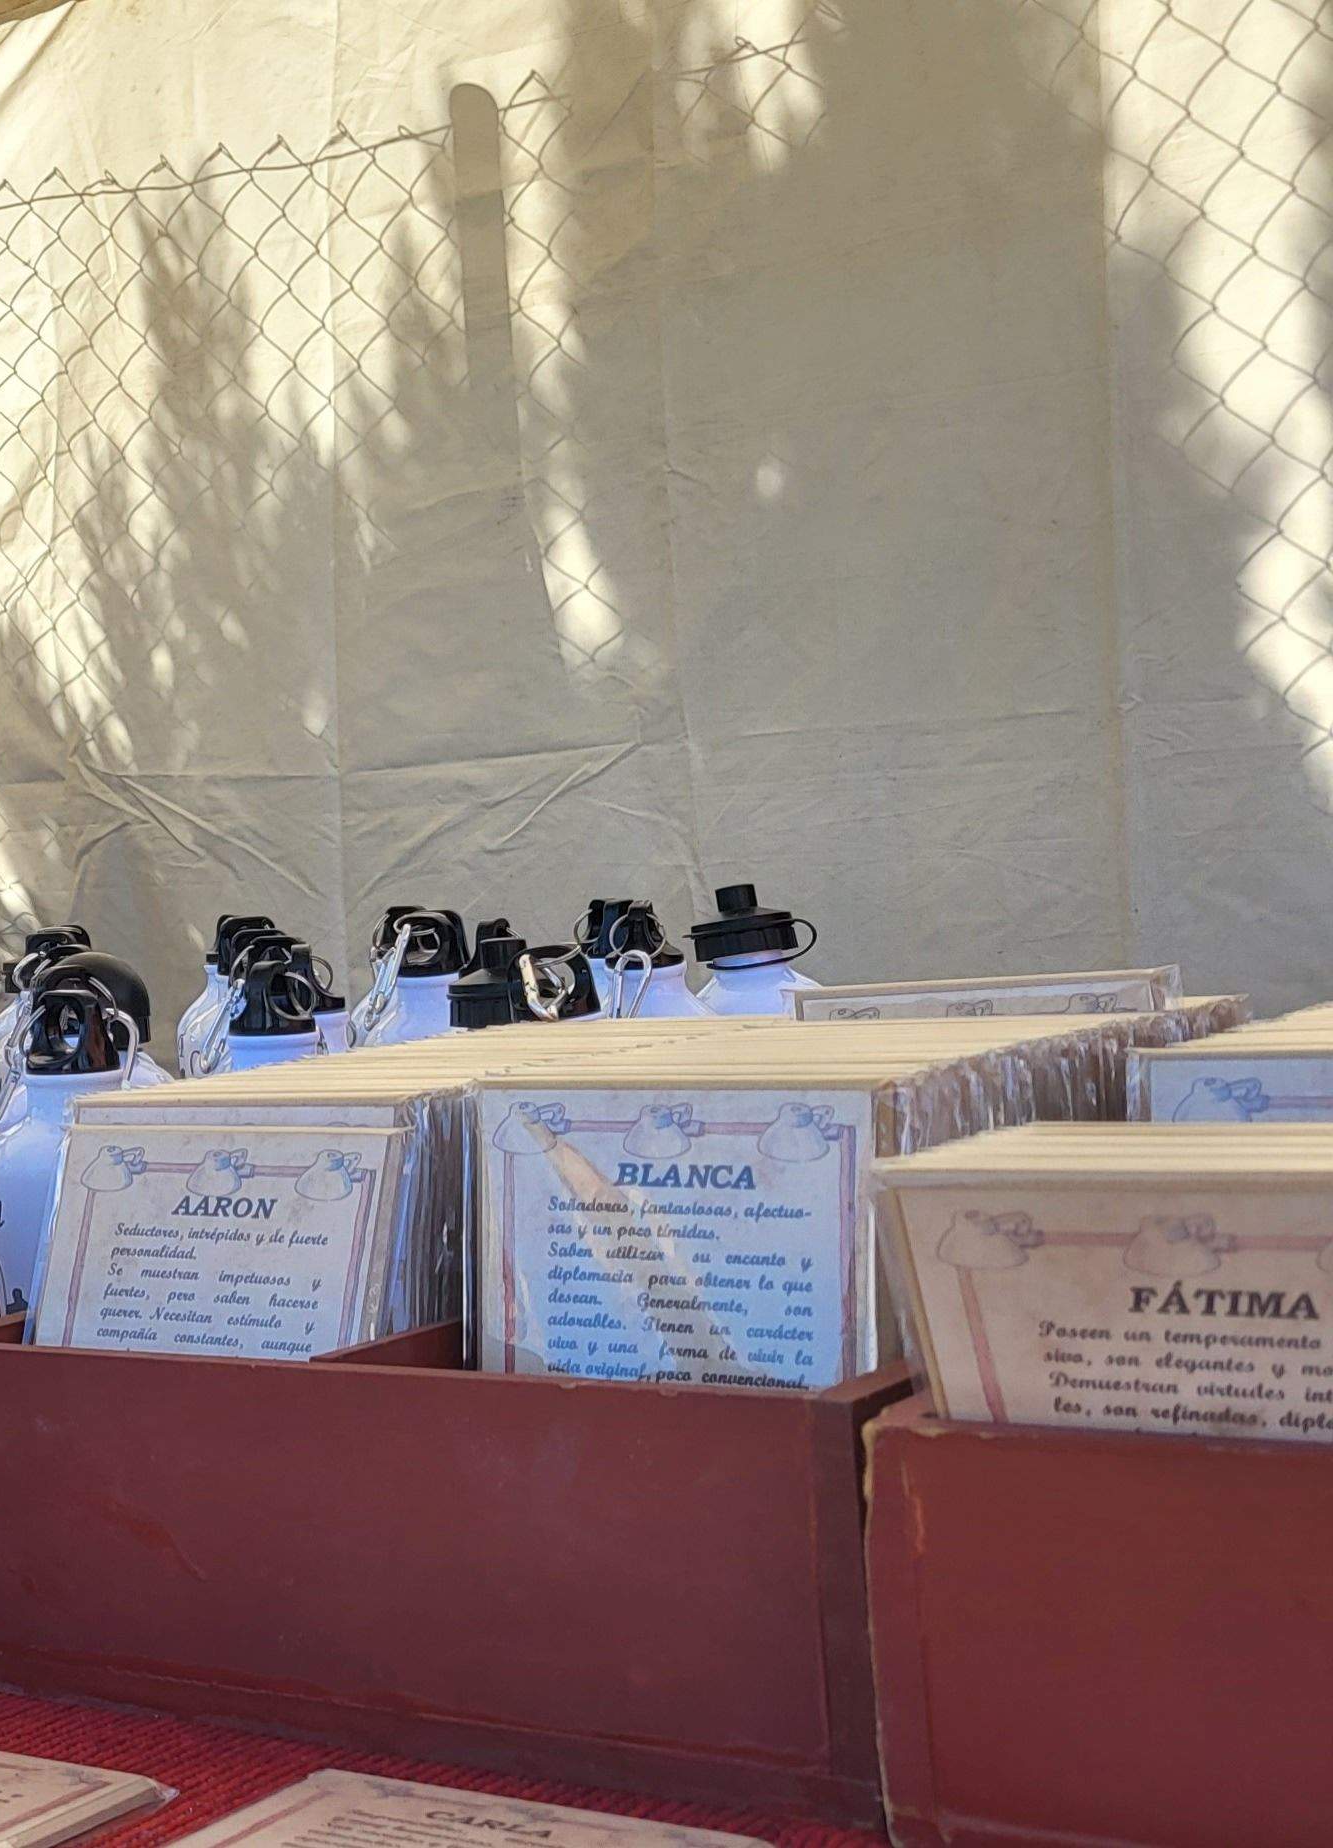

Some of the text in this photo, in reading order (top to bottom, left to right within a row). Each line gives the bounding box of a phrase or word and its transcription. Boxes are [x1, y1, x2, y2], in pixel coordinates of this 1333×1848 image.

[613, 1162, 756, 1190] BLANCA
[171, 1195, 278, 1219] AARON
[744, 1202, 812, 1222] afectuo-
[115, 1222, 329, 1248] Seductores, intrépidos y de fuerte
[547, 1222, 720, 1241] sas y un poco tímidas.
[111, 1245, 197, 1260] personalidad.
[547, 1241, 813, 1273] Saben utilizar su encanto y
[107, 1262, 322, 1292] Se muestran impetuosos y
[547, 1265, 813, 1296] diplomacia para obtener lo que
[103, 1283, 319, 1310] fuertes, pero saben hacerse
[637, 1292, 747, 1316] Generalmente,
[785, 1305, 813, 1317] son
[1128, 1279, 1320, 1319] FÁTIMA
[100, 1306, 315, 1335] querer. Necesitan estímulo y
[547, 1311, 813, 1341] adorables. Tienen un carácter
[1038, 1319, 1321, 1350] Poseen un temperamento
[96, 1327, 312, 1356] compañía constantes, aunque
[547, 1336, 813, 1366] vivo y una forma de vivir la
[547, 1358, 581, 1374] vida
[655, 1369, 692, 1384] poco
[1104, 1354, 1140, 1368] son
[1155, 1351, 1255, 1375] elegantes
[1271, 1363, 1285, 1379] y
[1048, 1370, 1179, 1394] Demuestran
[1197, 1382, 1285, 1400] virtudes
[1103, 1404, 1138, 1418] son
[426, 1810, 552, 1839] CARLA
